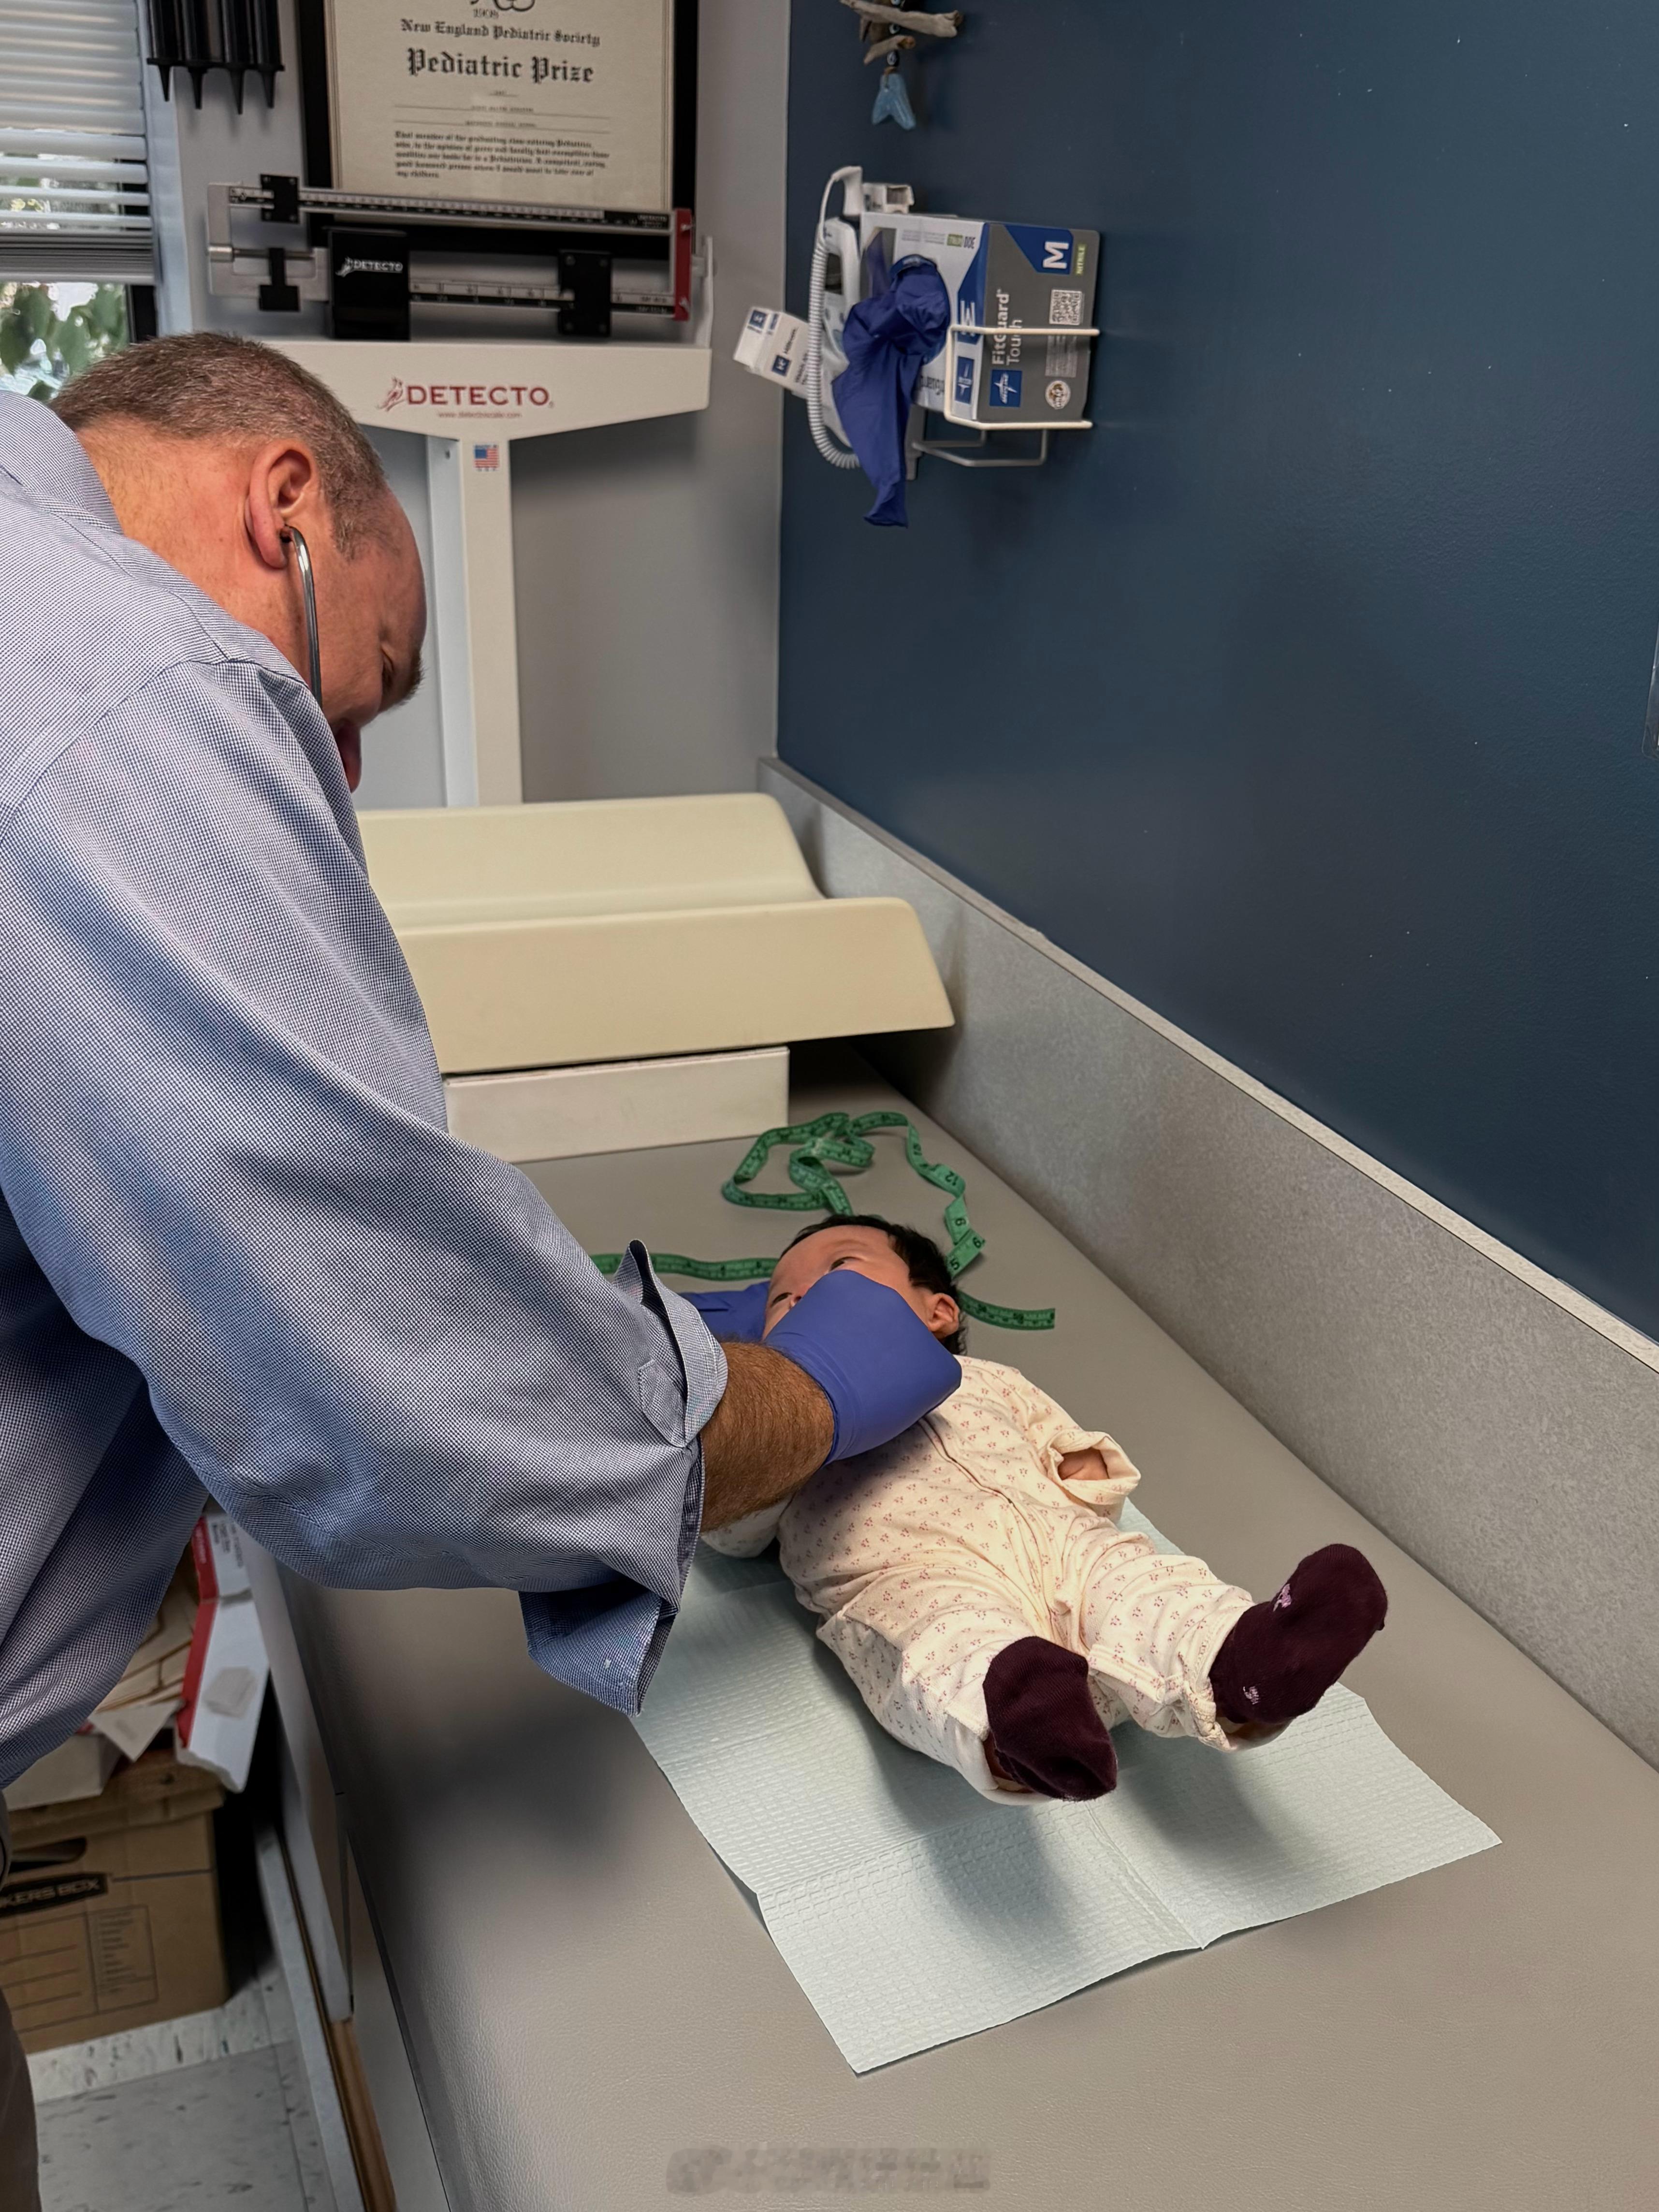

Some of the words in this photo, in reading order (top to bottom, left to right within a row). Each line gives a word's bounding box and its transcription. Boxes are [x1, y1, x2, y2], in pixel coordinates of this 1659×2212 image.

[401, 18, 431, 33] New
[435, 21, 489, 37] England
[493, 26, 549, 40] Pediatric
[553, 29, 600, 47] Society
[407, 47, 523, 78] Pediatric
[532, 56, 594, 84] Prize
[353, 260, 404, 272] DETECTO
[1042, 241, 1069, 269] M
[1076, 245, 1086, 275] NITRILE
[407, 385, 550, 406] DETECTO
[949, 1258, 961, 1271] 5
[58, 1878, 101, 1896] BOX
